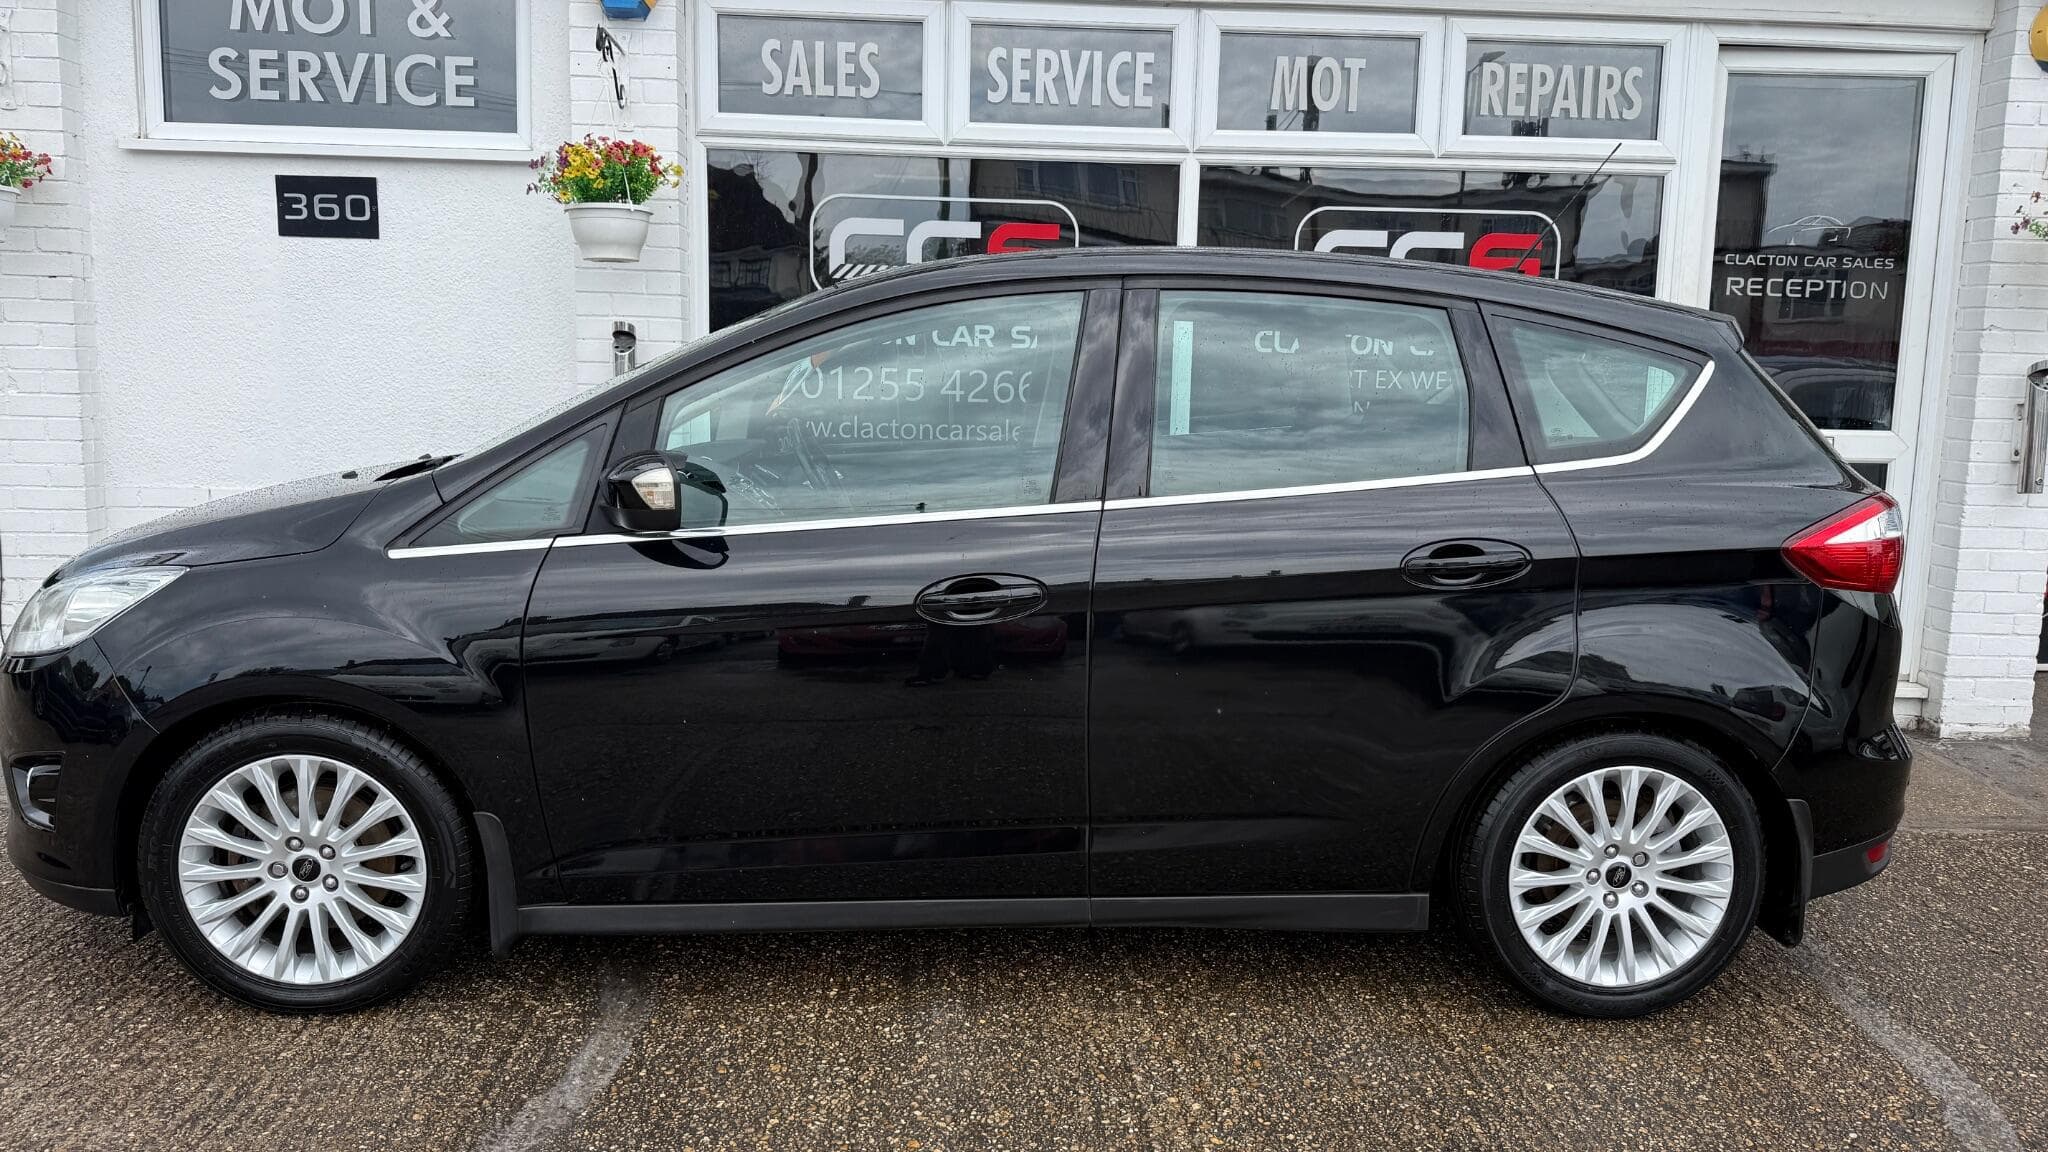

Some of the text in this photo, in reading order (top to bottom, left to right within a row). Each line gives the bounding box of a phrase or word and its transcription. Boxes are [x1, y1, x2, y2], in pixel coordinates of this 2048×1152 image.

[208, 47, 475, 107] SERVICE
[762, 39, 880, 98] SALES
[988, 47, 1153, 107] SERVICE
[1270, 56, 1367, 112] MOT
[1480, 62, 1643, 120] REPAIRS
[283, 192, 371, 221] 360
[1725, 253, 1895, 269] CLACTON CAR SALES
[1725, 277, 1889, 300] RECEPTION
[801, 365, 925, 401] 01255
[1376, 371, 1402, 390] EX
